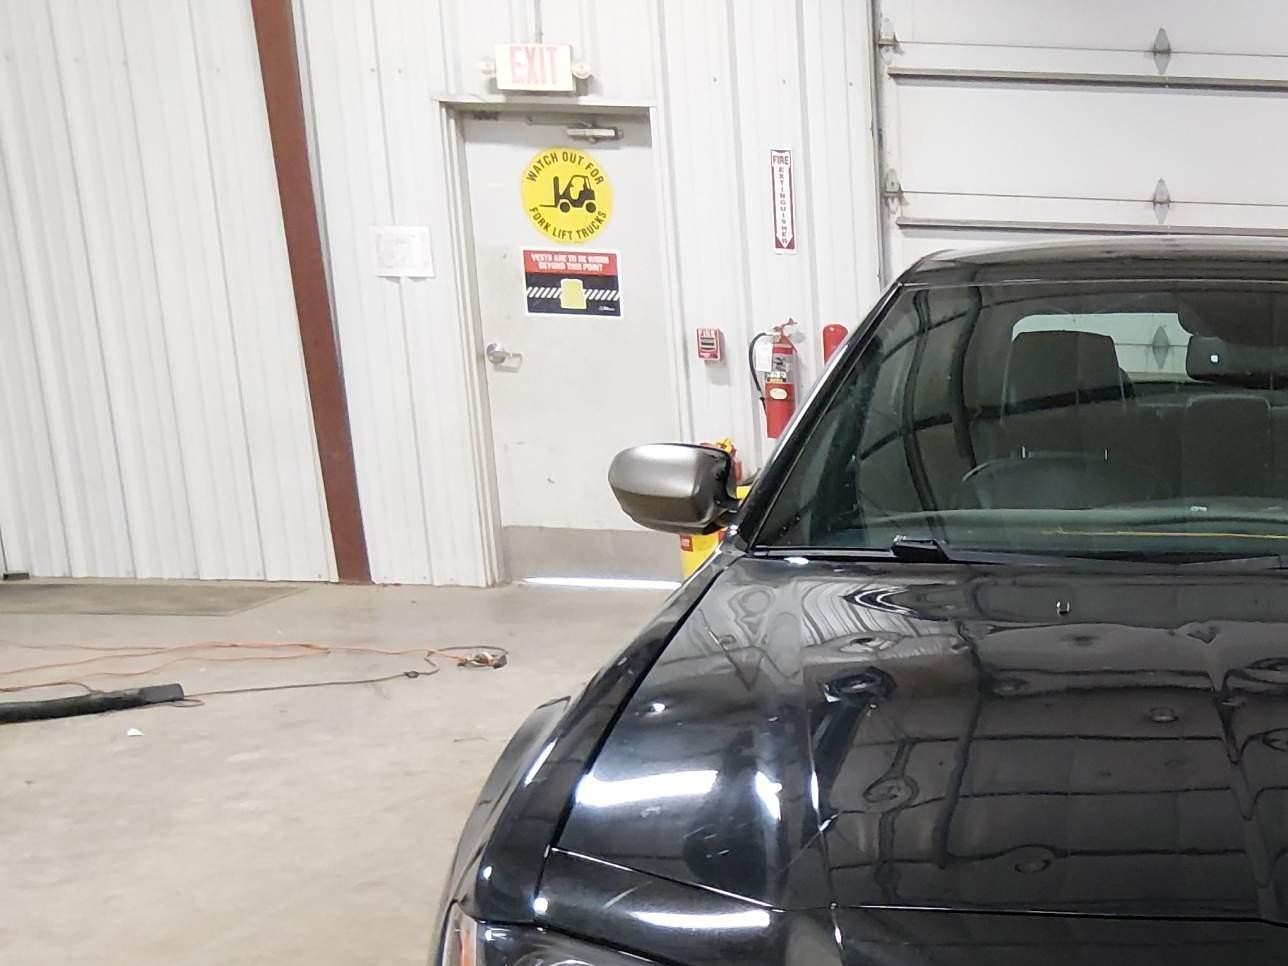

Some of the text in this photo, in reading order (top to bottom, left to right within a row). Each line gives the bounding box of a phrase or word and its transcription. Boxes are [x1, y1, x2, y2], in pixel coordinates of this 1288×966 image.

[510, 45, 558, 85] EXIT
[526, 151, 605, 185] WATCH OUT FOR
[772, 155, 790, 165] FIRE
[778, 166, 789, 244] EXTINGUISHER
[529, 207, 607, 241] FORK LIFT TRUCKS
[553, 254, 567, 263] ARE
[567, 255, 577, 263] TO
